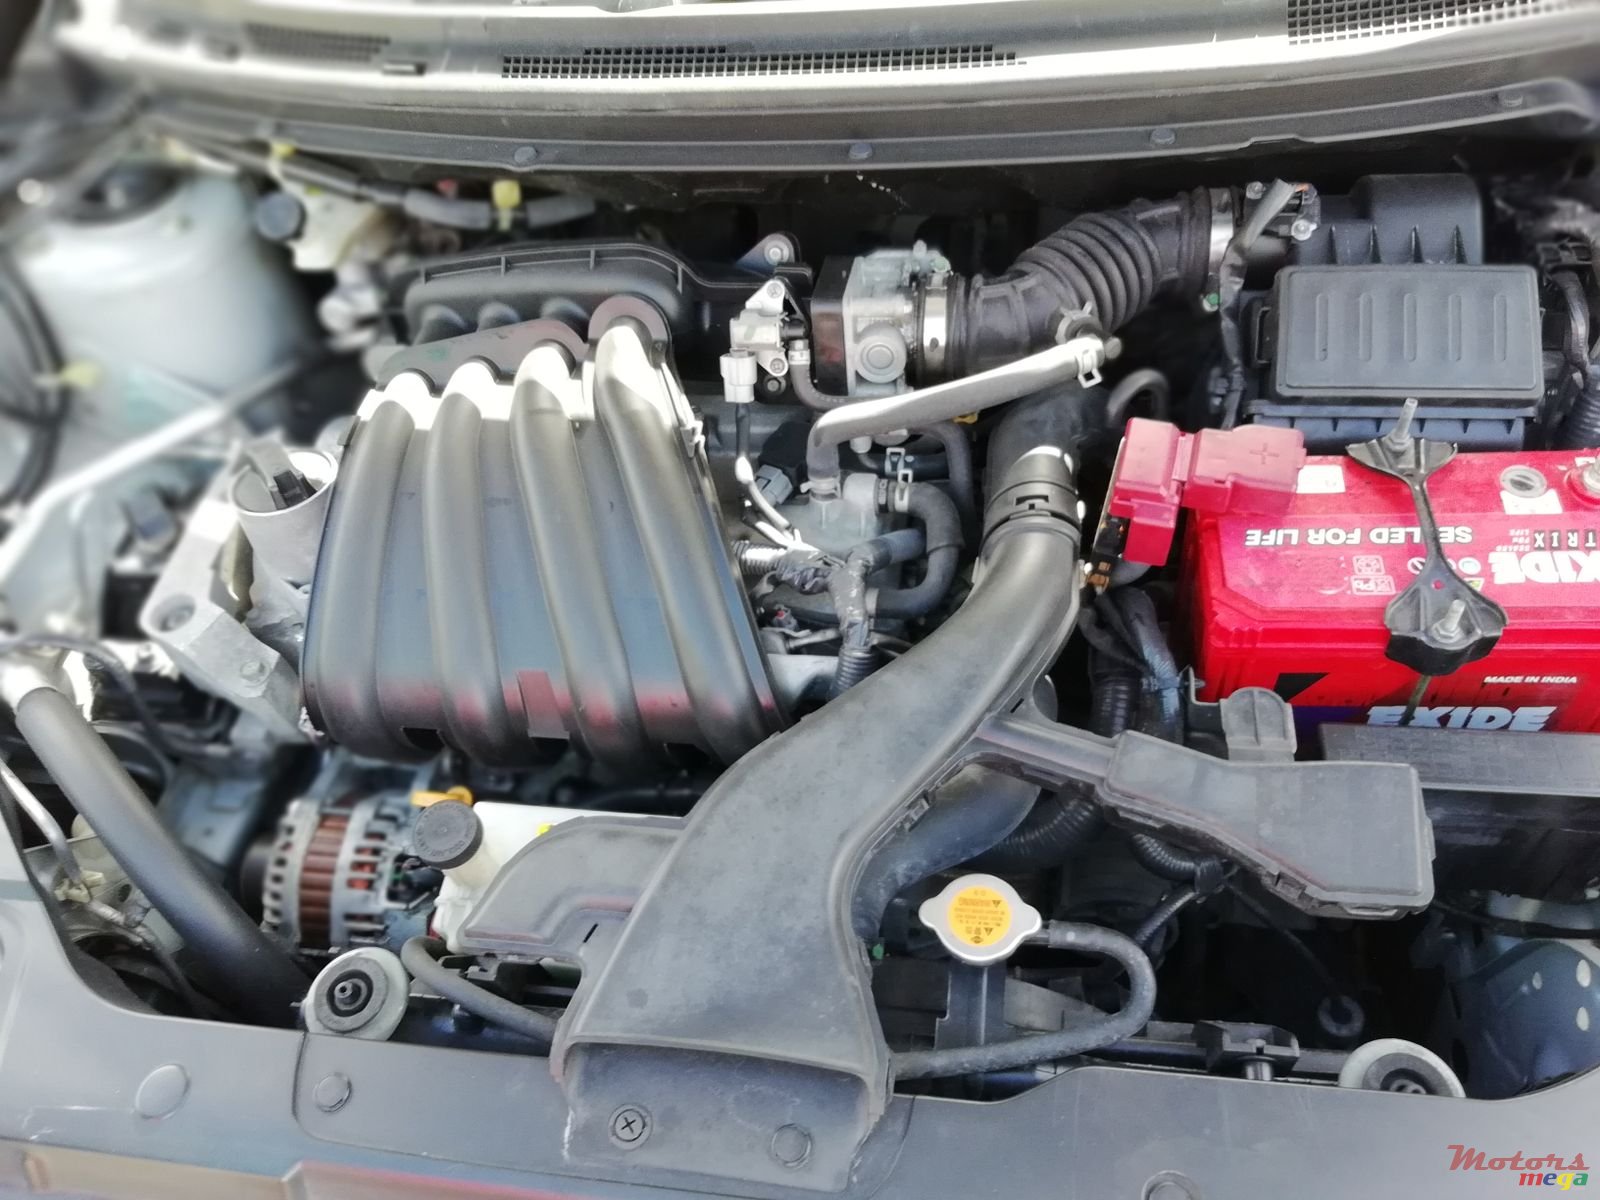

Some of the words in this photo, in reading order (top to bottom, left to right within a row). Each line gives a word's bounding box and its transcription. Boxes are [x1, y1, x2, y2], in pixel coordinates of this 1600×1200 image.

[1244, 528, 1299, 546] LIFE
[1307, 527, 1361, 545] FOR
[1369, 525, 1473, 544] SELED
[1533, 530, 1597, 549] TRIX
[1483, 675, 1524, 684] MADE
[1524, 675, 1540, 684] IN
[1541, 675, 1577, 684] INDIA
[1367, 705, 1557, 732] EXIDE
